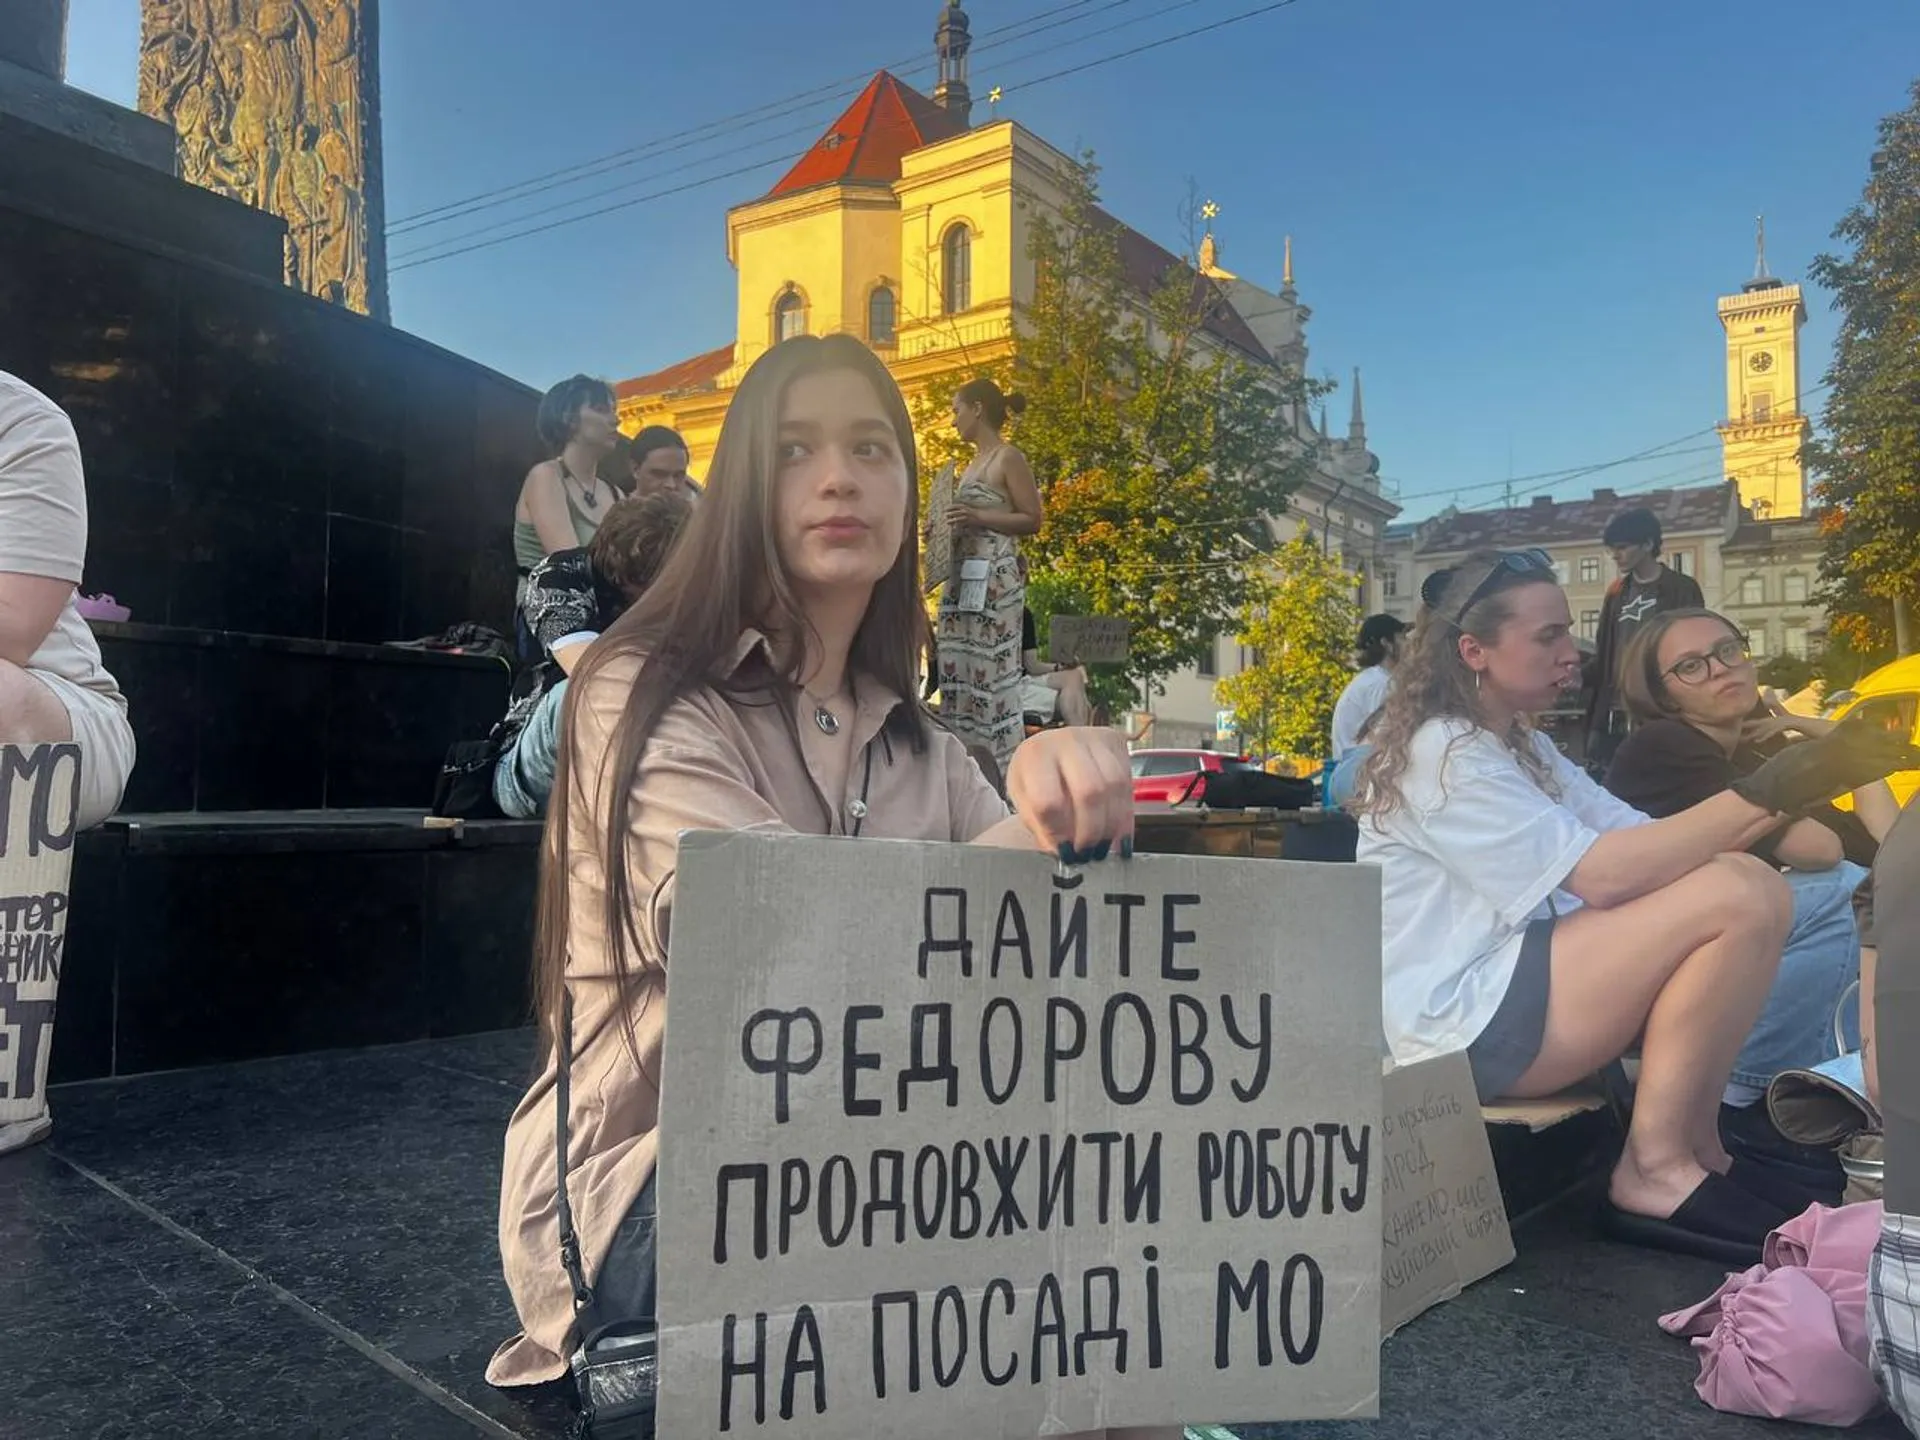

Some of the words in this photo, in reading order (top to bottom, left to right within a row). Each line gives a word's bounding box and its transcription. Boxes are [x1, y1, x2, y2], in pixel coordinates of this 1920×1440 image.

[0, 892, 68, 931] ТОР
[0, 932, 63, 982] НИК
[918, 874, 1200, 981] ДАЙТЕ
[742, 992, 1271, 1124] ФЕДОРОВУ
[714, 1132, 1163, 1264] ПРОДОВЖИТИ
[1198, 1123, 1371, 1222] РОБОТУ
[720, 1305, 828, 1432] НА
[1215, 1254, 1324, 1369] МО
